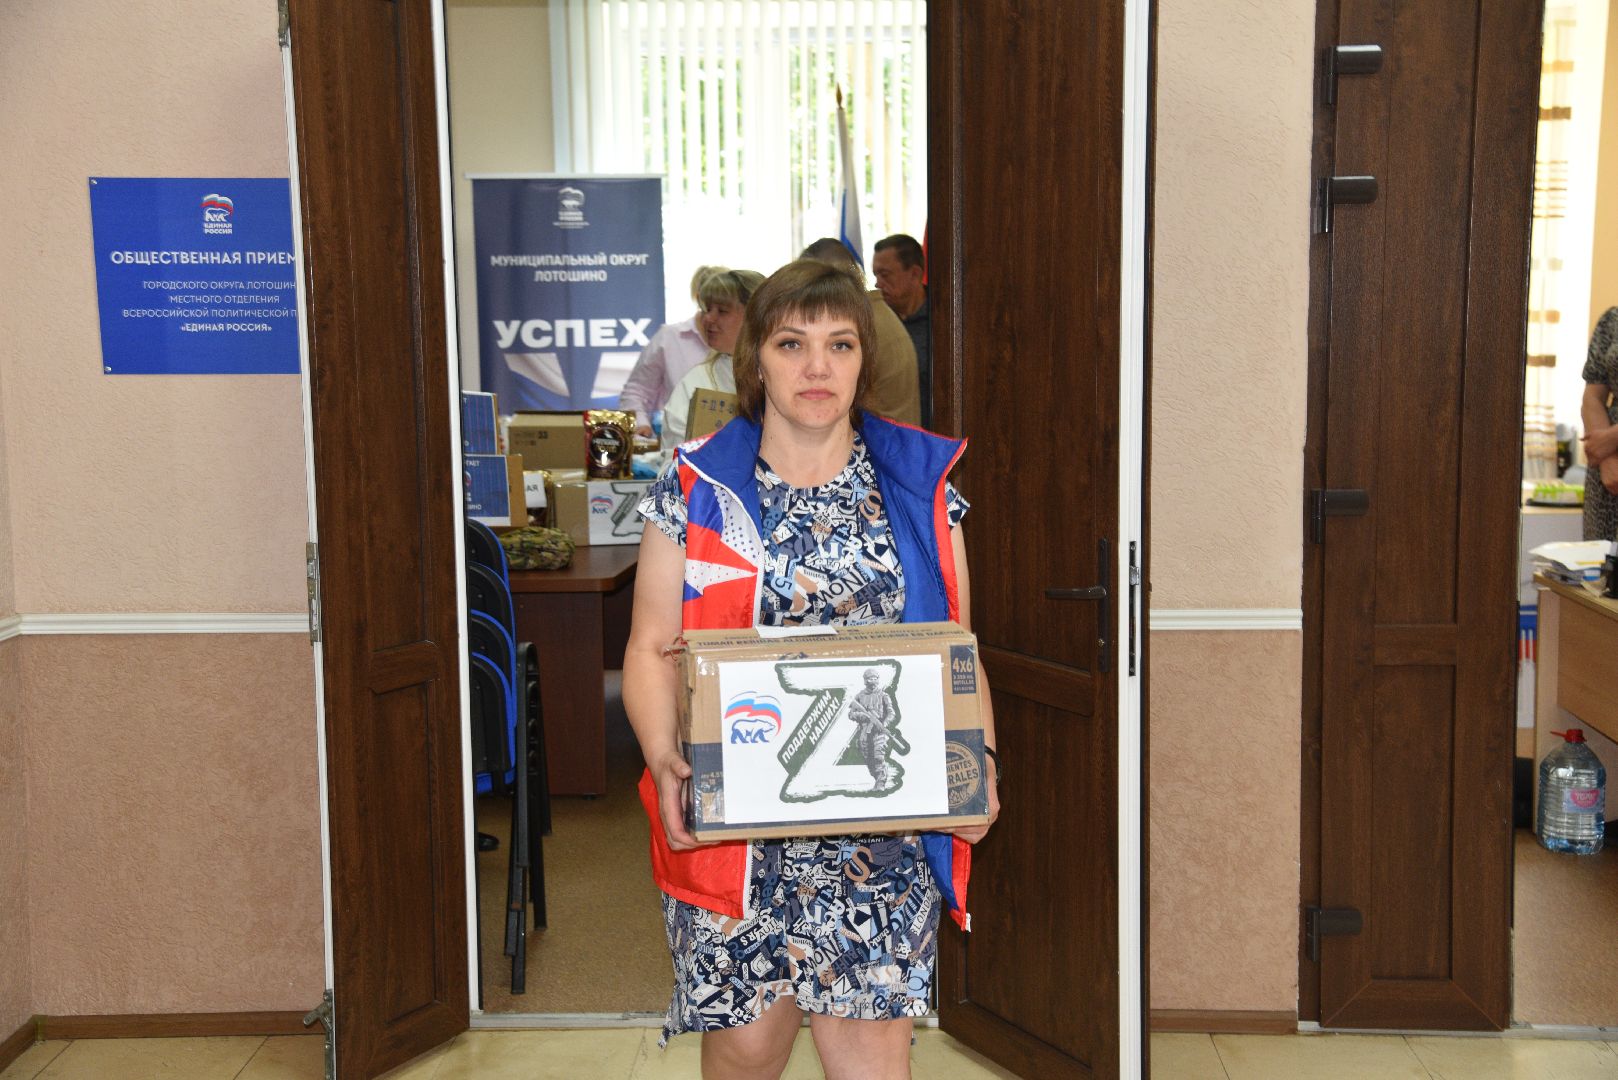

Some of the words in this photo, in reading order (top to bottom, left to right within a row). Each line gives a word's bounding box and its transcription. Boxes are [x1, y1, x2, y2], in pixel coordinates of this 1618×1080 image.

[111, 251, 241, 266] ОБЩЕСТВЕННАЯ
[490, 252, 608, 267] МУНИЦИПАЛЬНЫЙ
[609, 253, 649, 265] ОКРУГ
[534, 269, 608, 282] ЛОТОШИНО
[143, 281, 208, 290] ГОРОДСКОГО
[210, 281, 245, 289] ОКРУГА
[170, 295, 222, 304] МЕСТНОГО
[224, 295, 280, 304] ОТДЕЛЕНИЯ
[123, 308, 209, 318] ВСЕРОССИЙСКОЙ
[211, 308, 288, 317] ПОЛИТИЧЕСКОЙ
[181, 323, 224, 333] «ЕДИНАЯ
[227, 323, 272, 332] РОССИЯ»
[492, 318, 652, 349] УСПЕХ
[781, 690, 832, 764] ПОДДЕРЖИМ
[808, 696, 841, 746] НАШИХ!
